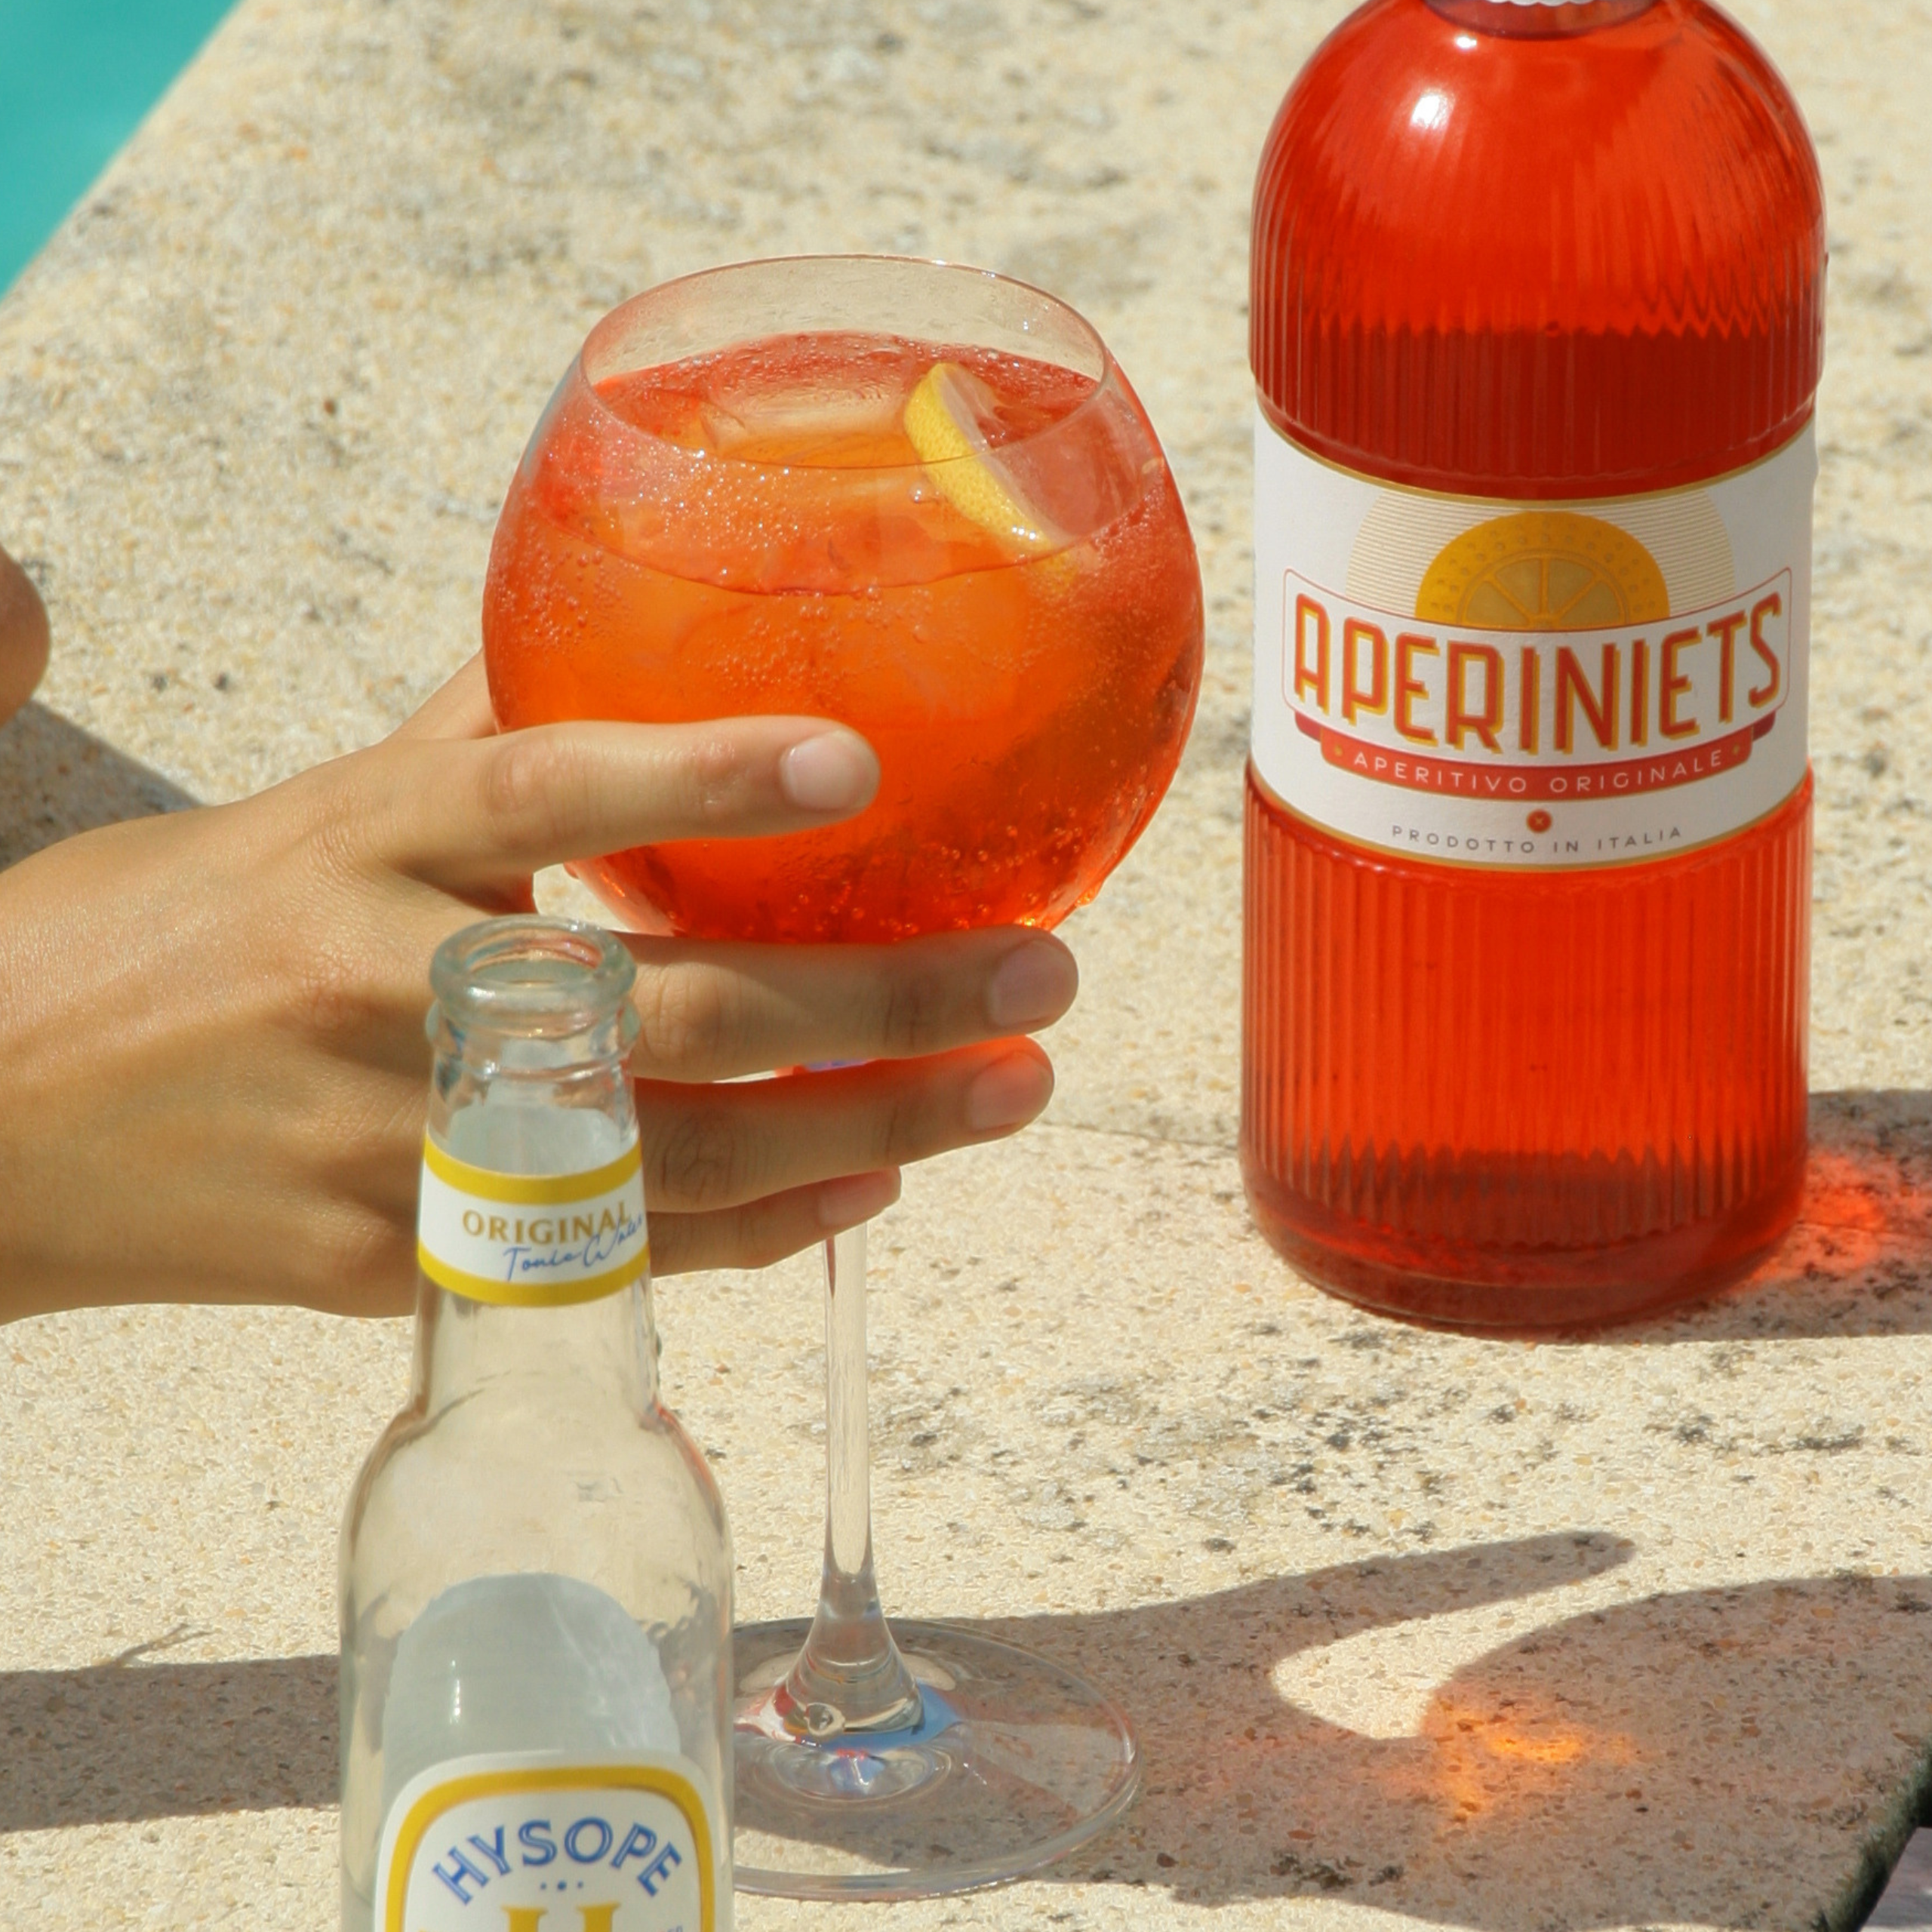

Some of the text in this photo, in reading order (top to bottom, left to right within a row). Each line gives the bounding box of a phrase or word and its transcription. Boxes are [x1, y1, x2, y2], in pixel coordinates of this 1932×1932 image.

[1294, 592, 1784, 754] APERINIETS
[1354, 749, 1721, 793] APERITIVO ORIGINALE
[1392, 825, 1681, 854] PRODOTTO IN ITALIA
[463, 1199, 631, 1245] ORIGINAL
[503, 1212, 643, 1281] Tonic Water
[432, 1817, 683, 1906] HYSOPE
